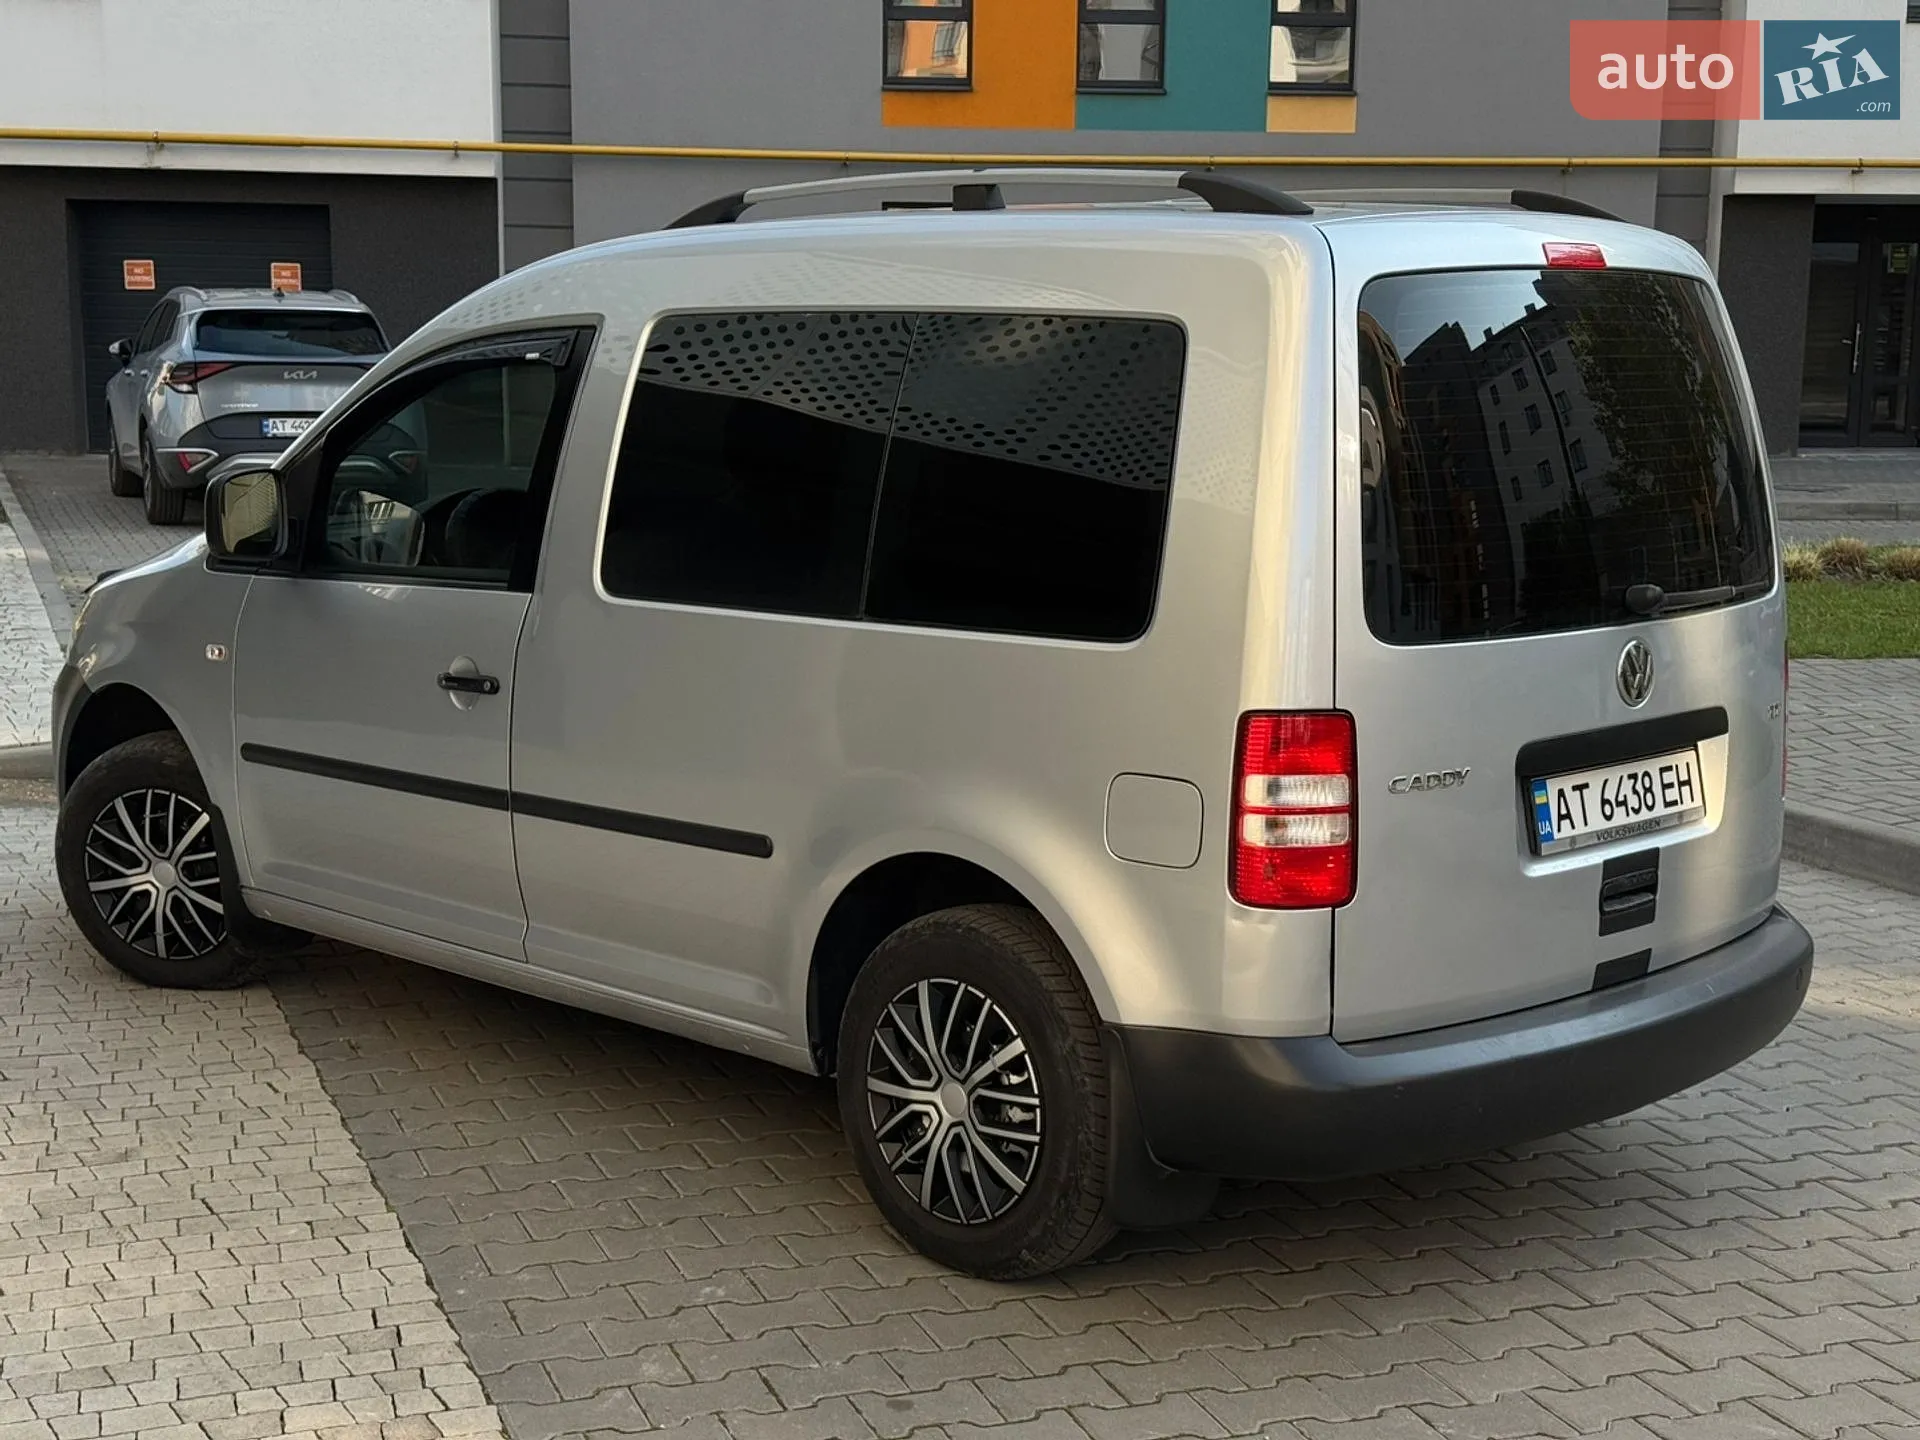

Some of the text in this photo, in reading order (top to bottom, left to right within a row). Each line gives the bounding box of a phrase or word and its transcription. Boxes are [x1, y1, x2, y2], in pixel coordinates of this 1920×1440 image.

[271, 419, 315, 432] AT 442
[1388, 767, 1471, 794] CADDY
[1557, 762, 1694, 833] AT 6438 EH
[1538, 822, 1551, 835] UA
[1596, 819, 1661, 841] VOLKSWAGEN
